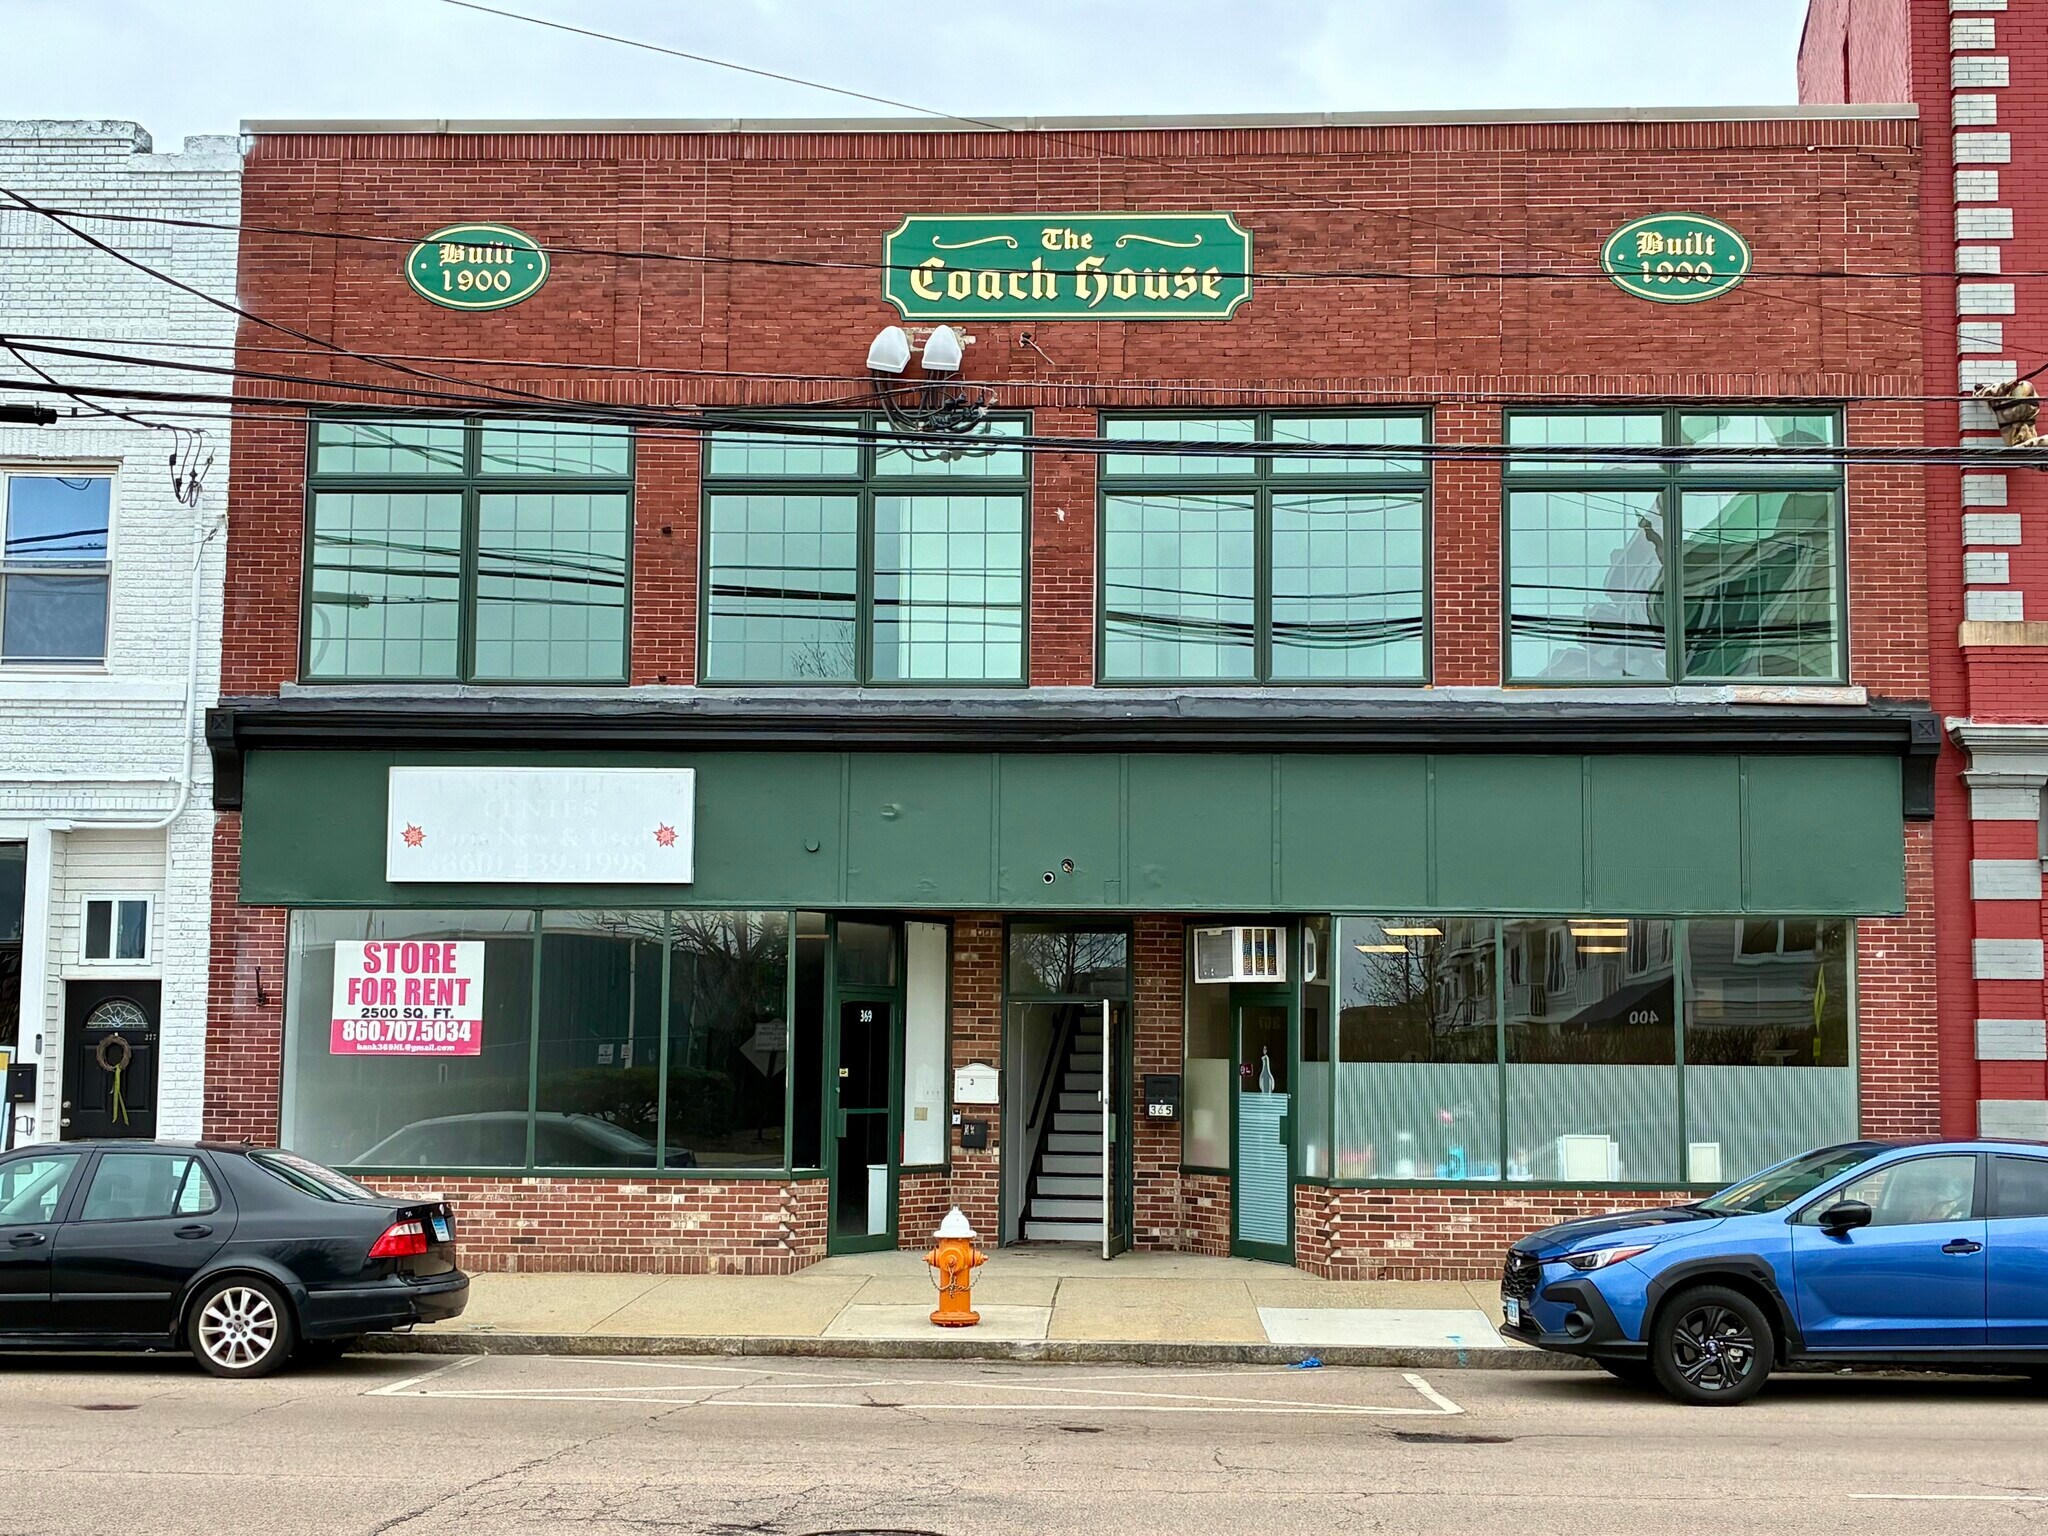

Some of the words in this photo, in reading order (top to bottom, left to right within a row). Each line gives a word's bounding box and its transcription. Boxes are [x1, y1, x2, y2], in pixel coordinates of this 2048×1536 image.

[1041, 228, 1093, 250] The
[1636, 231, 1715, 258] Built
[439, 241, 515, 266] Built
[442, 270, 512, 292] 1900
[910, 256, 1059, 301] Coach
[1075, 254, 1224, 308] House
[1640, 261, 1713, 284] 1900
[363, 942, 457, 974] STORE
[348, 978, 397, 1006] FOR
[404, 978, 471, 1006] RENT
[361, 1008, 398, 1019] 2500
[403, 1008, 428, 1019] SQ.
[434, 1008, 454, 1019] FT.
[859, 1009, 873, 1023] 369
[342, 1020, 471, 1042] 860.707.5034
[1150, 1105, 1172, 1115] 365
